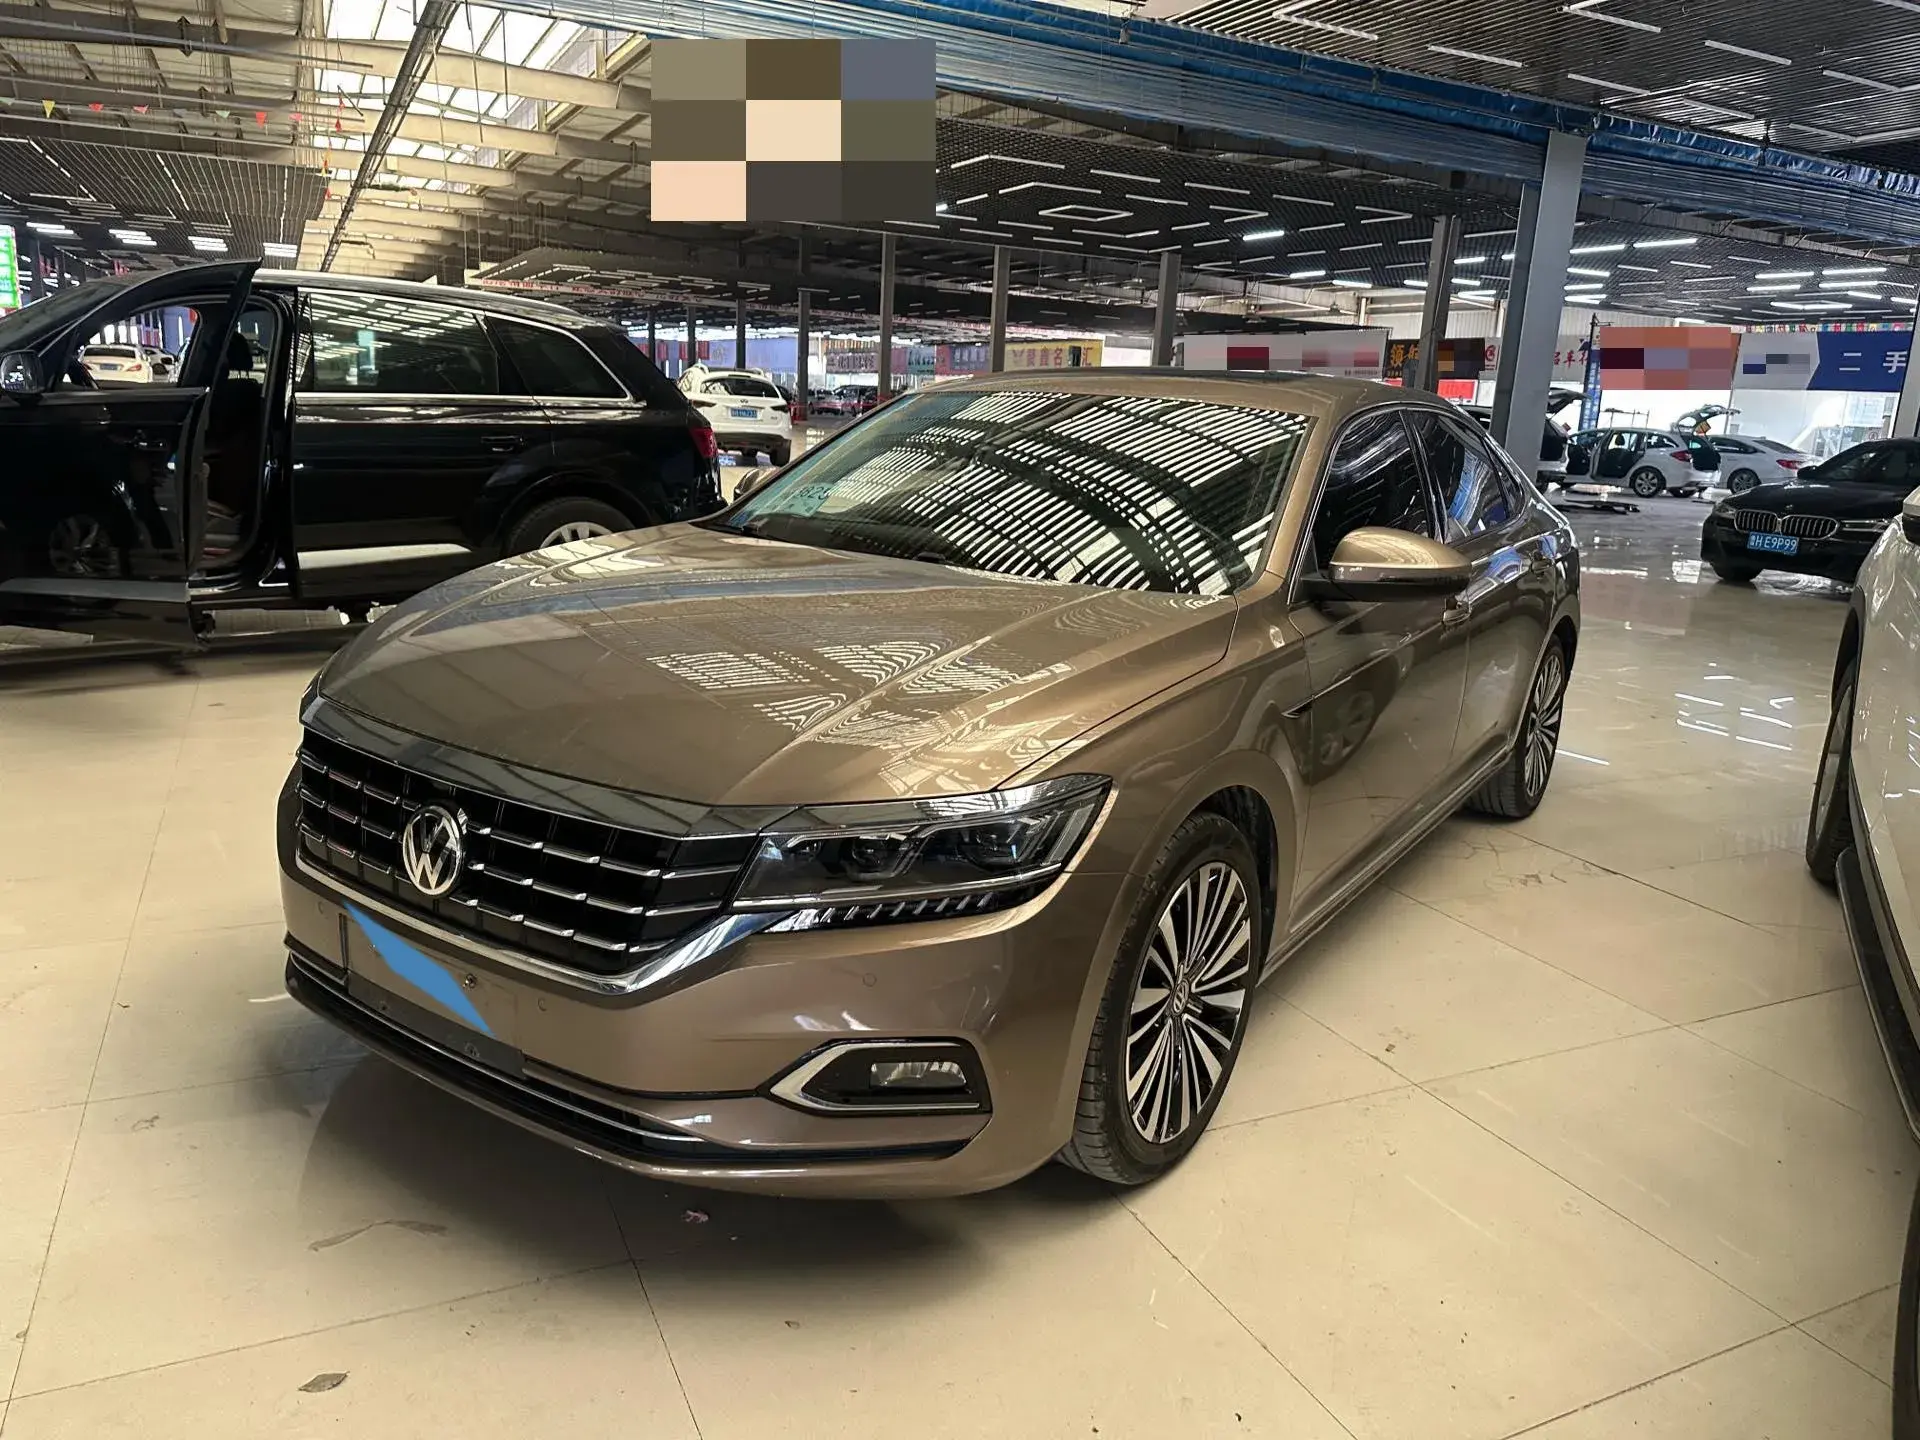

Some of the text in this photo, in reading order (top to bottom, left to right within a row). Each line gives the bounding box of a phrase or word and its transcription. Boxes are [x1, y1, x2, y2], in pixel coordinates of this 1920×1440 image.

[1027, 345, 1093, 366] 聚鑫名汇
[1839, 351, 1908, 373] 二手
[403, 806, 459, 894] VW
